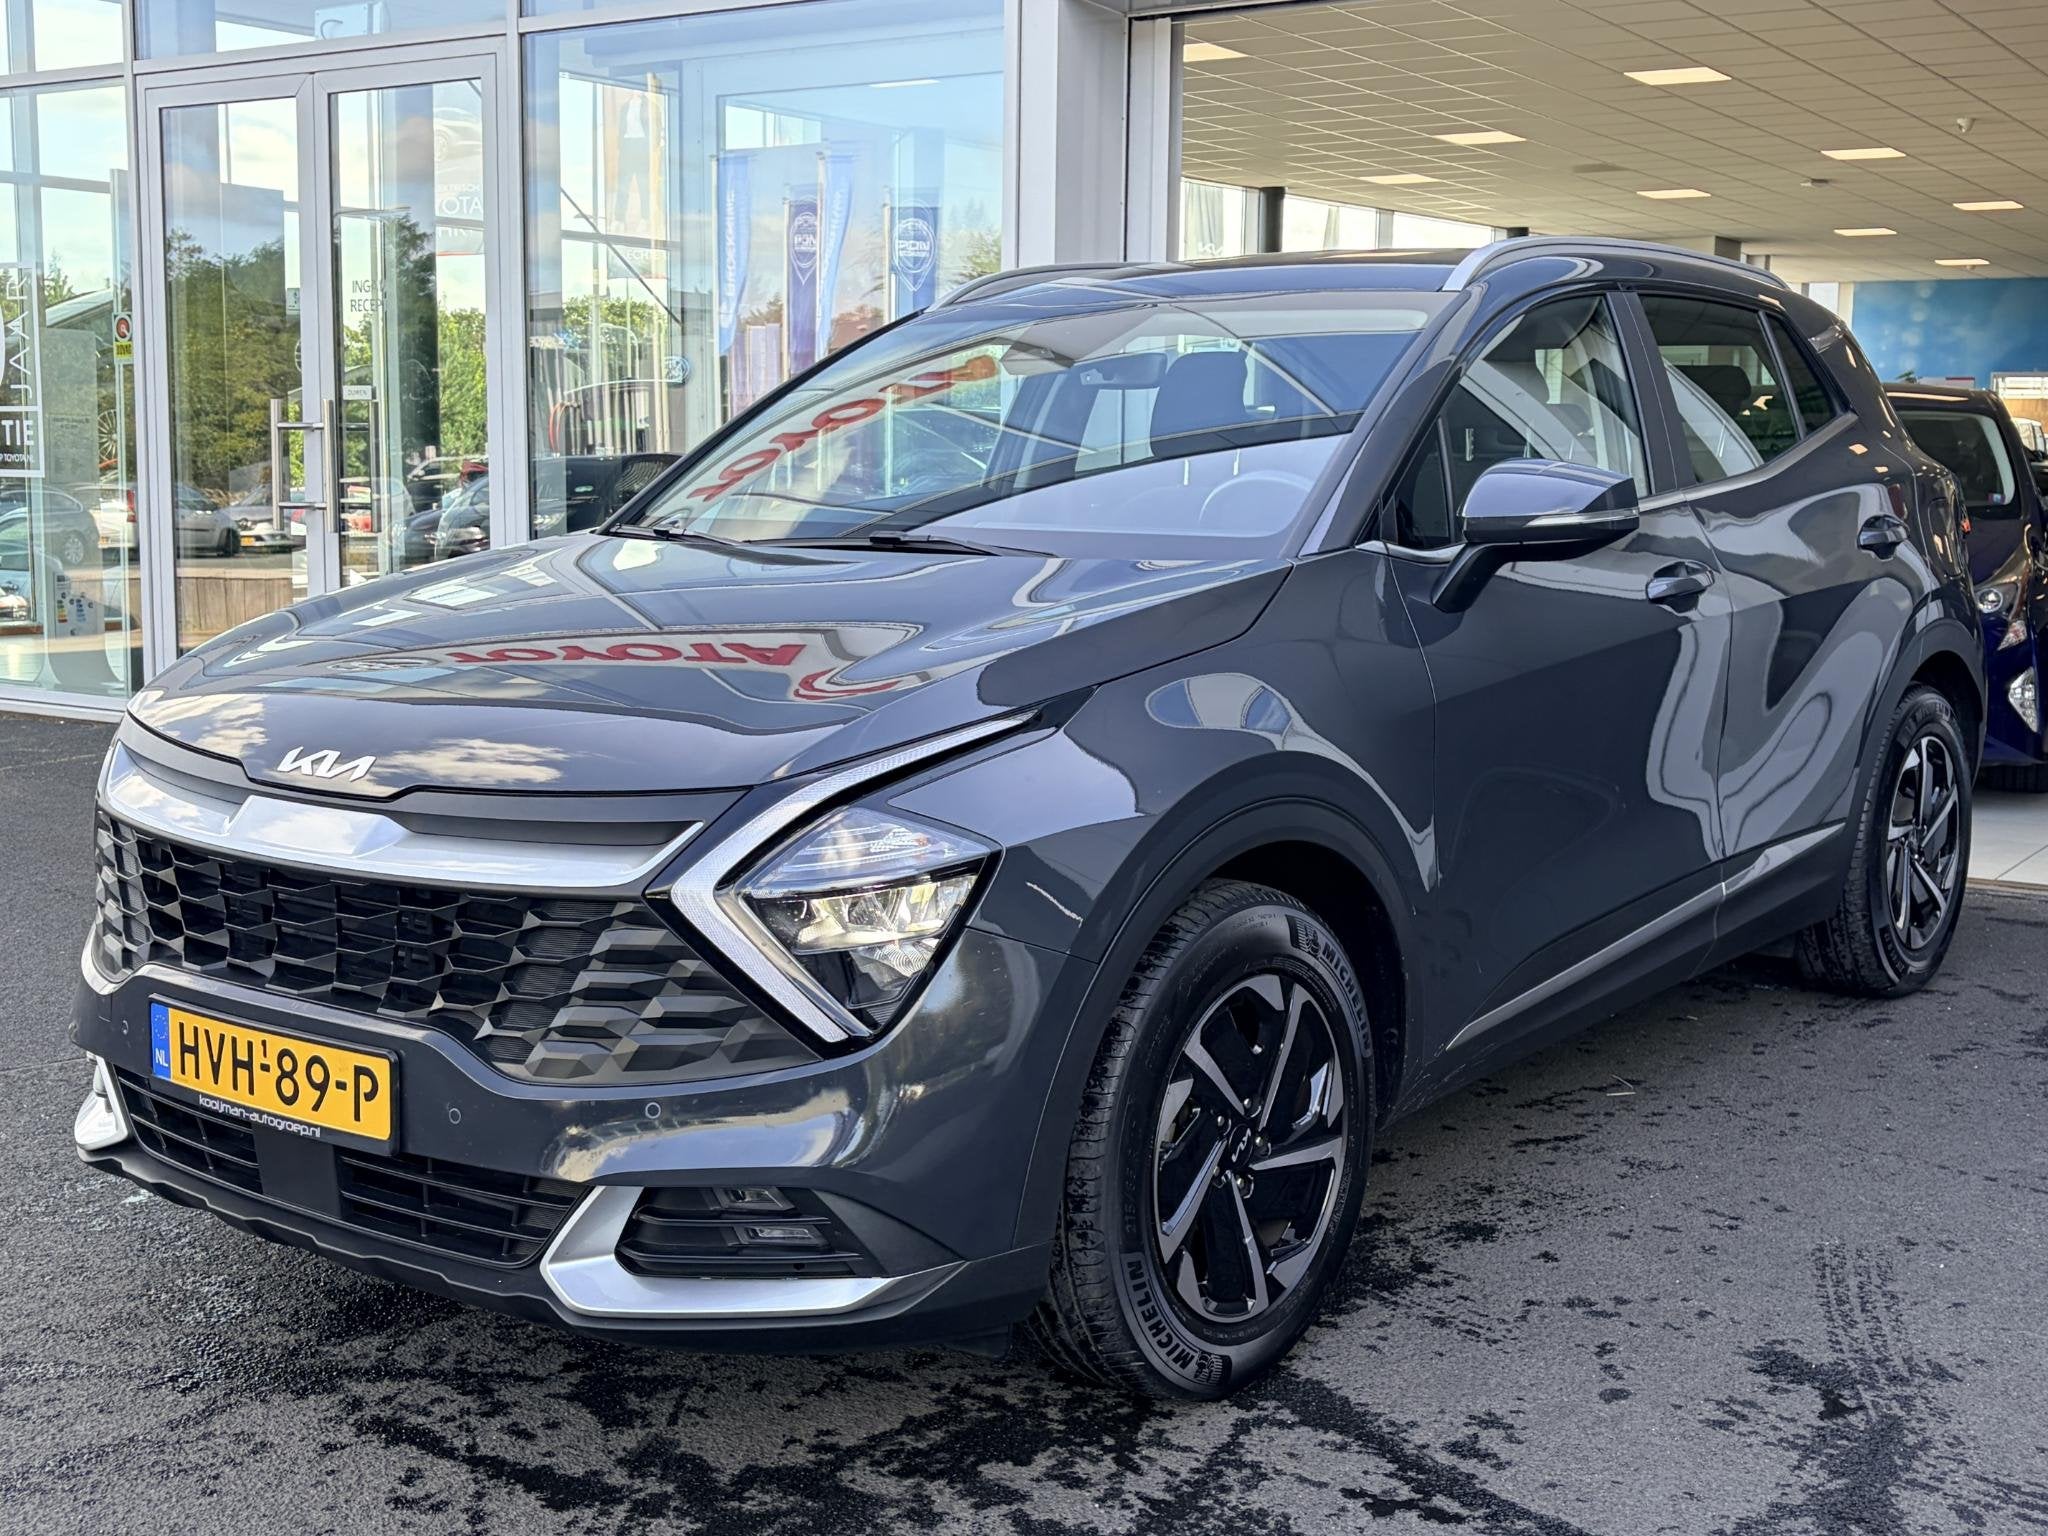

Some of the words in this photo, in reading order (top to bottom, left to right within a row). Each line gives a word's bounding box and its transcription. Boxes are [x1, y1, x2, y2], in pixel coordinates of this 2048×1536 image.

[437, 196, 483, 215] OTA
[6, 276, 32, 399] JAAR
[1322, 942, 1371, 1051] MICHELIN
[155, 1048, 168, 1067] NL
[178, 1021, 379, 1122] HVH-89-P
[199, 1095, 321, 1138] kooijman-autogroep.nl
[1127, 1260, 1193, 1371] MICHELIN
